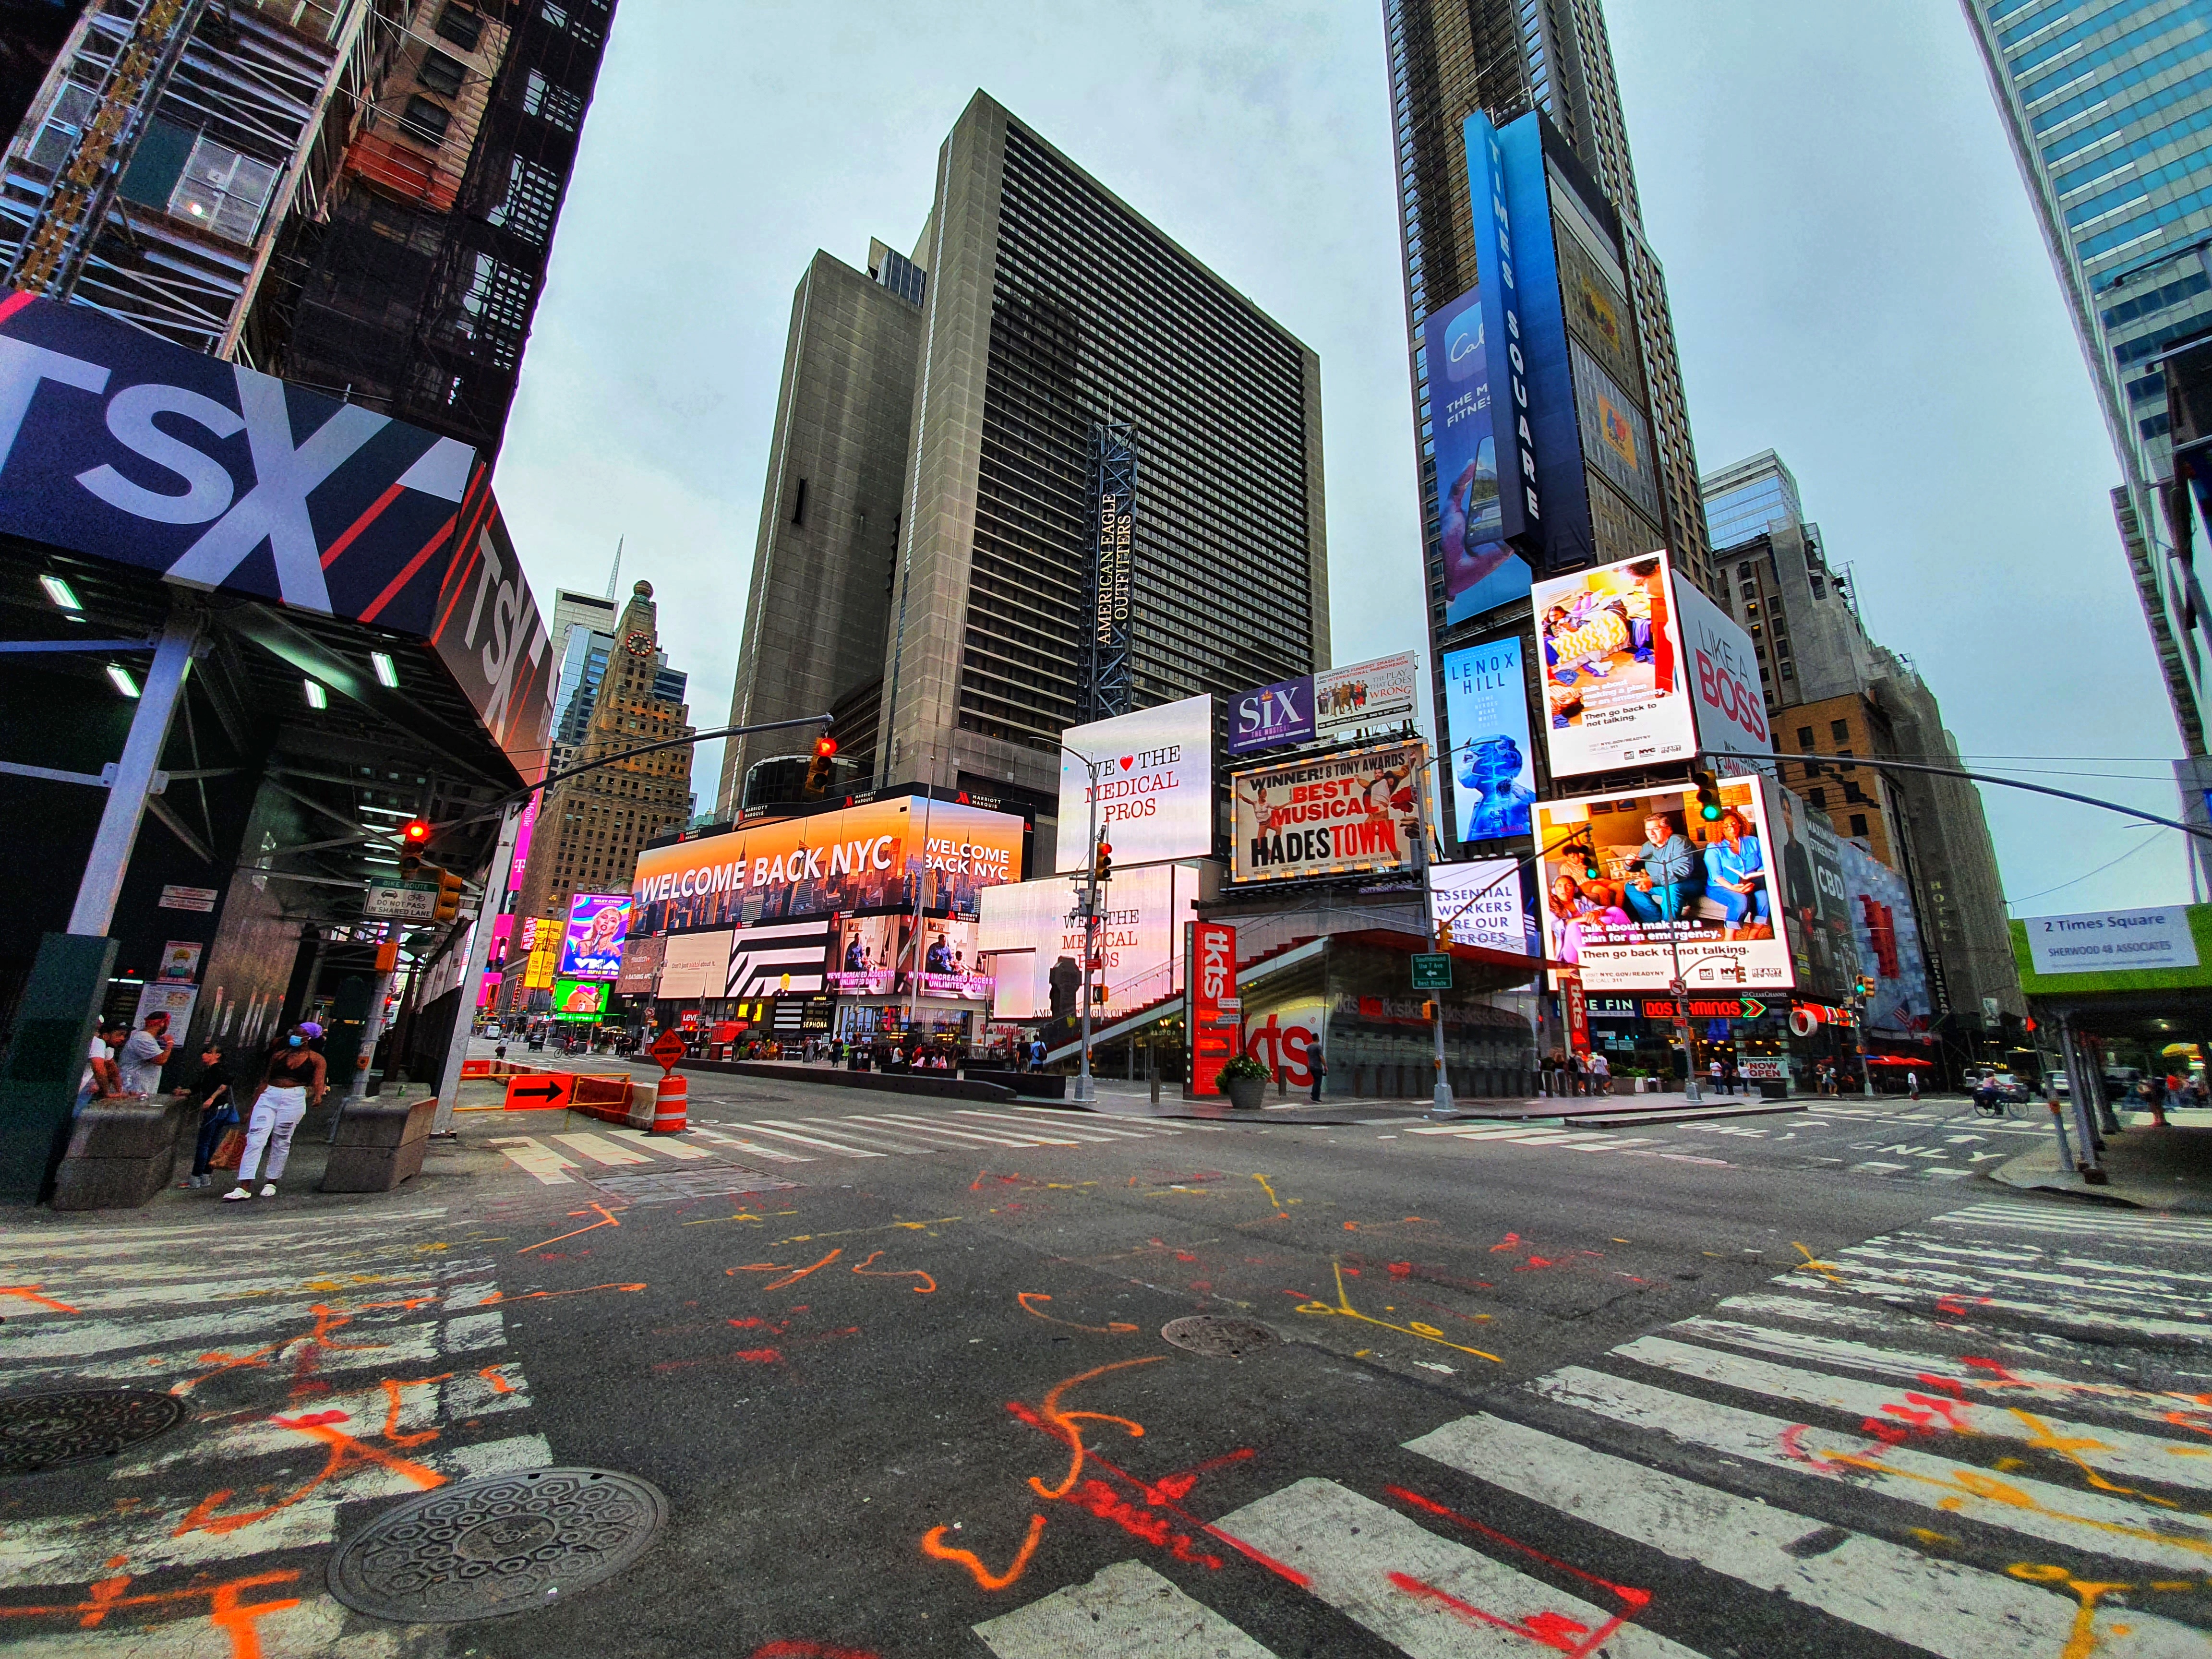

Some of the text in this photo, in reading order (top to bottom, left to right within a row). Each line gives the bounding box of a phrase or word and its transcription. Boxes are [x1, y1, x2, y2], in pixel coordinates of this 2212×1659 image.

[1489, 137, 1539, 521] TIMES SQUARE
[1446, 392, 1472, 413] THE
[0, 335, 394, 617] TSX
[1097, 493, 1117, 645] AMERICAN EAGLE
[1114, 514, 1131, 620] OUTFITTERS
[1698, 620, 1751, 688] LIKE A
[1318, 669, 1350, 680] BROADWAY'S
[1350, 663, 1375, 673] FUNNIEST
[1327, 670, 1368, 682] INTERNATIONAL
[1370, 660, 1408, 672] PHENOMENON
[1387, 668, 1407, 680] PLAY
[1452, 652, 1514, 680] LENOX
[1370, 675, 1412, 690] THAT GOES
[1463, 673, 1505, 695] HILL
[1369, 685, 1412, 699] WRONG
[1695, 648, 1766, 743] BOSS
[1238, 686, 1303, 734] SIX
[1475, 701, 1498, 710] HEROES
[1623, 705, 1645, 713] back
[1603, 714, 1637, 724] talking.
[1085, 745, 1180, 780] WE THE
[1250, 752, 1406, 791] WINNER! 8 TONY AWARDS
[854, 791, 877, 799] MARRIOTT
[1084, 771, 1179, 804] MEDICAL
[1292, 778, 1355, 804] BEST
[854, 796, 873, 805] MARQUIS
[972, 794, 1001, 804] MARRIOTT
[972, 800, 998, 809] MARQUIS
[745, 810, 764, 818] MARQUIS
[1103, 798, 1156, 823] PROS
[1271, 797, 1380, 828] MUSICAL
[923, 836, 1010, 865] WELCOME
[1251, 819, 1398, 867] HADESTOWN
[641, 835, 893, 903] WELCOME BACK NYC
[922, 854, 1009, 880] BACK NYC
[382, 880, 429, 890] BIKE ROUTE
[1817, 865, 1844, 901] CBD
[1436, 886, 1513, 902] ESSENTIAL
[377, 906, 409, 915] SHARED
[410, 909, 432, 917] LANE
[1437, 901, 1512, 916] WORKERS
[1931, 880, 1952, 942] HOTEL
[1107, 909, 1139, 926] THE
[1475, 916, 1509, 928] OUR
[1578, 919, 1702, 933] Talk about makng a
[2044, 915, 2165, 932] 2 Times Square
[1061, 930, 1138, 950] MEDICAL
[1581, 933, 1607, 944] plan
[1608, 933, 1628, 942] for
[1629, 932, 1645, 941] an
[1582, 945, 1750, 959] Then go back to not talking.
[2048, 940, 2172, 957] SHERWOOD 48 ASSOCIATES
[1204, 930, 1229, 999] tkts
[887, 970, 895, 978] TO
[930, 972, 994, 985] INCREASED ACCESS
[929, 980, 982, 991] UNLIMITED DATA
[1605, 999, 1634, 1010] FIN
[1646, 1002, 1674, 1016] DOS
[1749, 1070, 1781, 1078] OPEN
